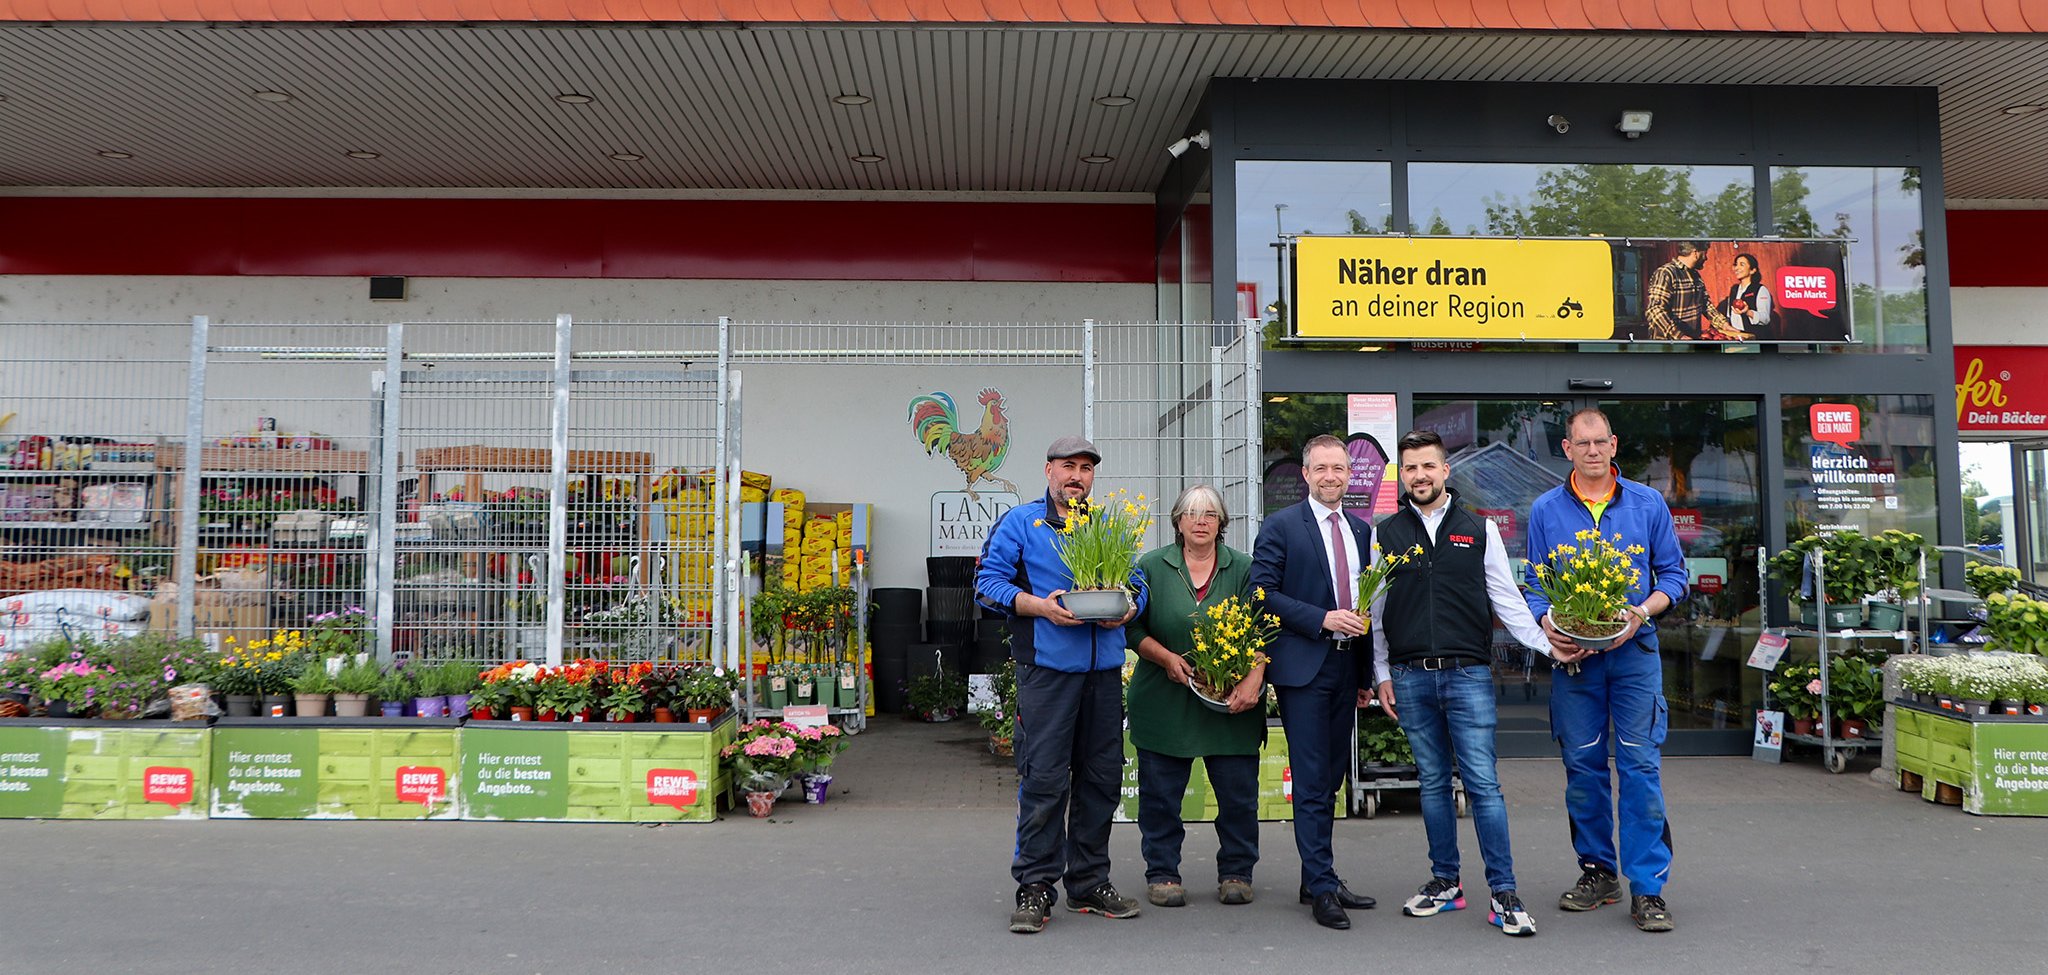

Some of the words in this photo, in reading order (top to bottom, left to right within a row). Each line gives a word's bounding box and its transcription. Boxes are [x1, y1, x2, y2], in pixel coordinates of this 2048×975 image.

[1338, 258, 1418, 284] Näher
[1426, 260, 1487, 285] dran
[1784, 276, 1827, 288] REWE
[1785, 290, 1801, 299] Dein
[1803, 290, 1827, 299] Markt
[1331, 299, 1358, 316] an
[1368, 294, 1438, 317] deiner
[1449, 294, 1524, 324] Region
[1816, 411, 1853, 423] REWE
[1968, 411, 1998, 424] Dein
[2001, 411, 2047, 424] Bäcker
[1817, 423, 1832, 433] DEIN
[1833, 423, 1853, 433] MARKT
[1812, 455, 1868, 469] Herzlich
[1812, 470, 1895, 483] willkommen
[1817, 488, 1860, 496] Öffnungszeiten:
[1487, 515, 1509, 524] EWE
[1674, 515, 1696, 524] EWE
[938, 525, 990, 540] MAR
[1449, 534, 1475, 545] REWE
[0, 752, 40, 763] erntest
[229, 751, 251, 763] Hier
[254, 752, 293, 764] erntest
[478, 752, 501, 765] Hier
[503, 753, 542, 766] erntest
[1994, 748, 2016, 760] Hier
[10, 765, 49, 777] besten
[228, 766, 243, 778] du
[245, 766, 261, 778] die
[263, 766, 302, 778] besten
[478, 768, 492, 780] du
[494, 767, 511, 780] die
[513, 768, 551, 780] besten
[1994, 763, 2009, 775] du
[2012, 763, 2028, 775] die
[150, 773, 187, 785] REWE
[402, 773, 438, 785] REWE
[654, 776, 690, 788] REWE
[149, 785, 164, 794] Dein
[165, 786, 187, 795] Markt
[228, 780, 284, 796] Angebote.
[402, 786, 417, 794] Dein
[418, 786, 438, 795] Markt
[477, 781, 535, 797] Angebote.
